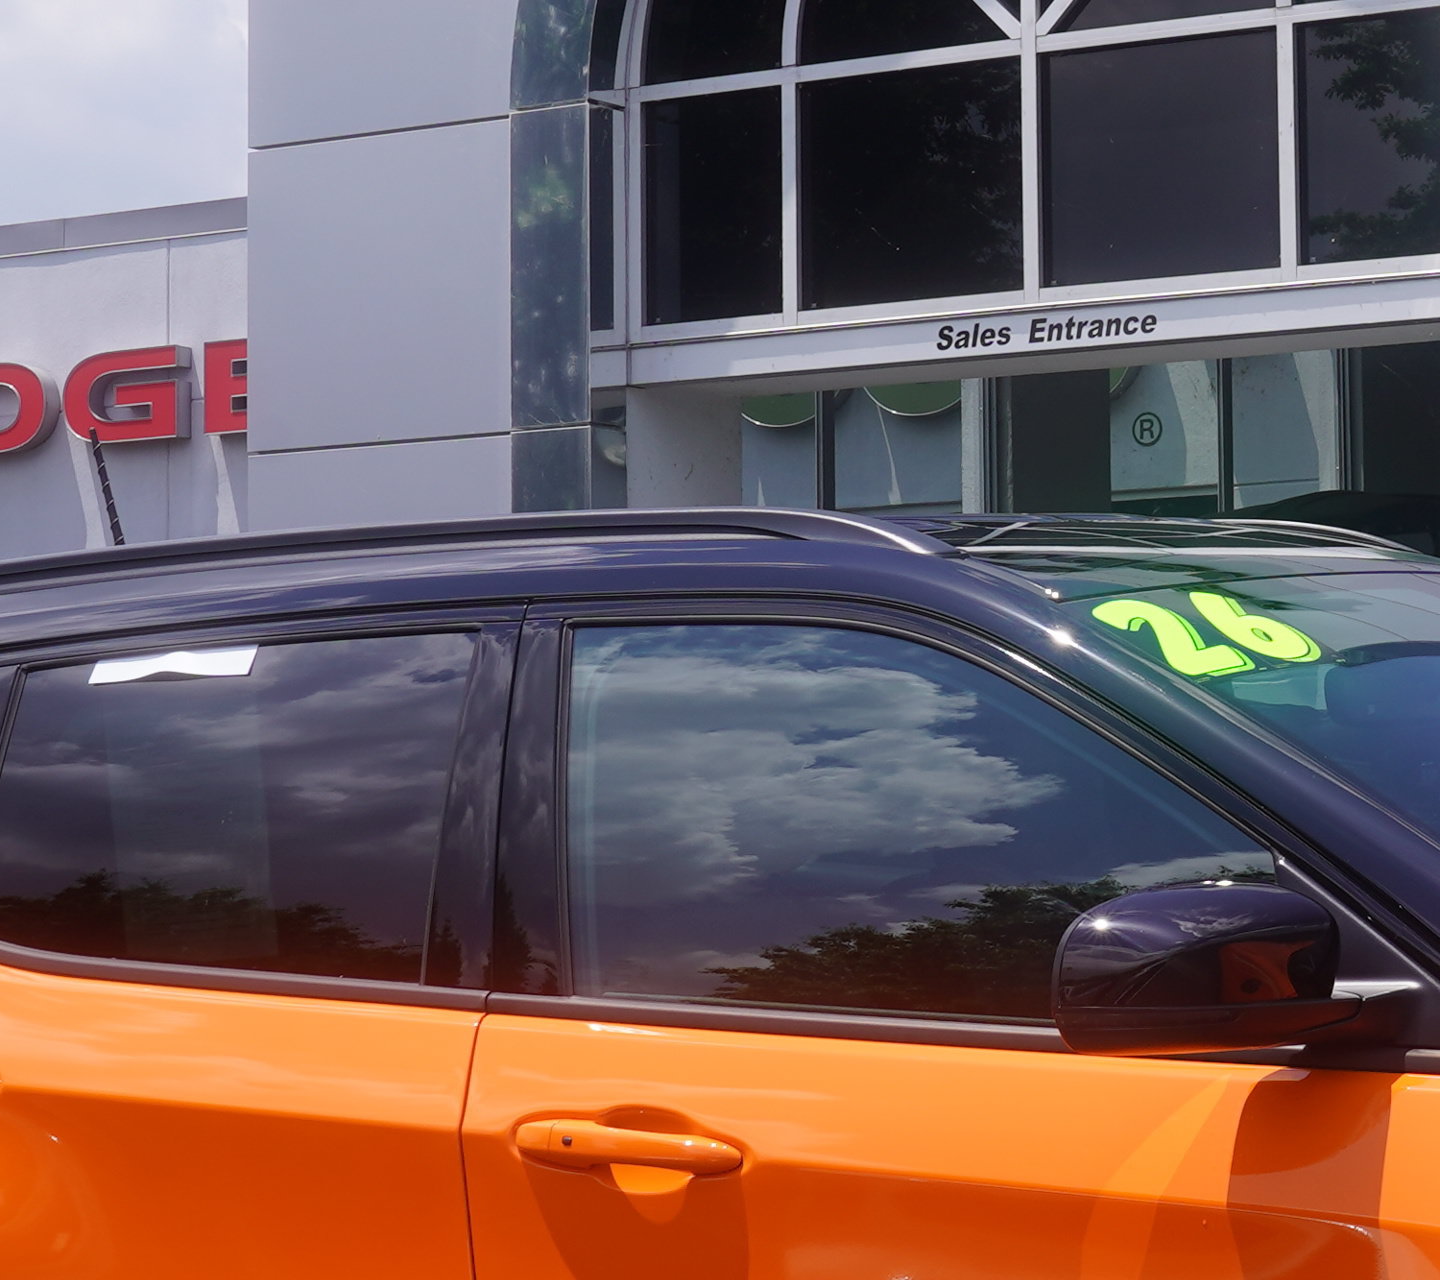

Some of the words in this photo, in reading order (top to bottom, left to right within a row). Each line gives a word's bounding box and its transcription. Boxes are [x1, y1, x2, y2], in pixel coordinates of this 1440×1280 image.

[936, 323, 1012, 351] Sales
[1028, 314, 1158, 344] Entrance
[1091, 591, 1322, 677] 26
